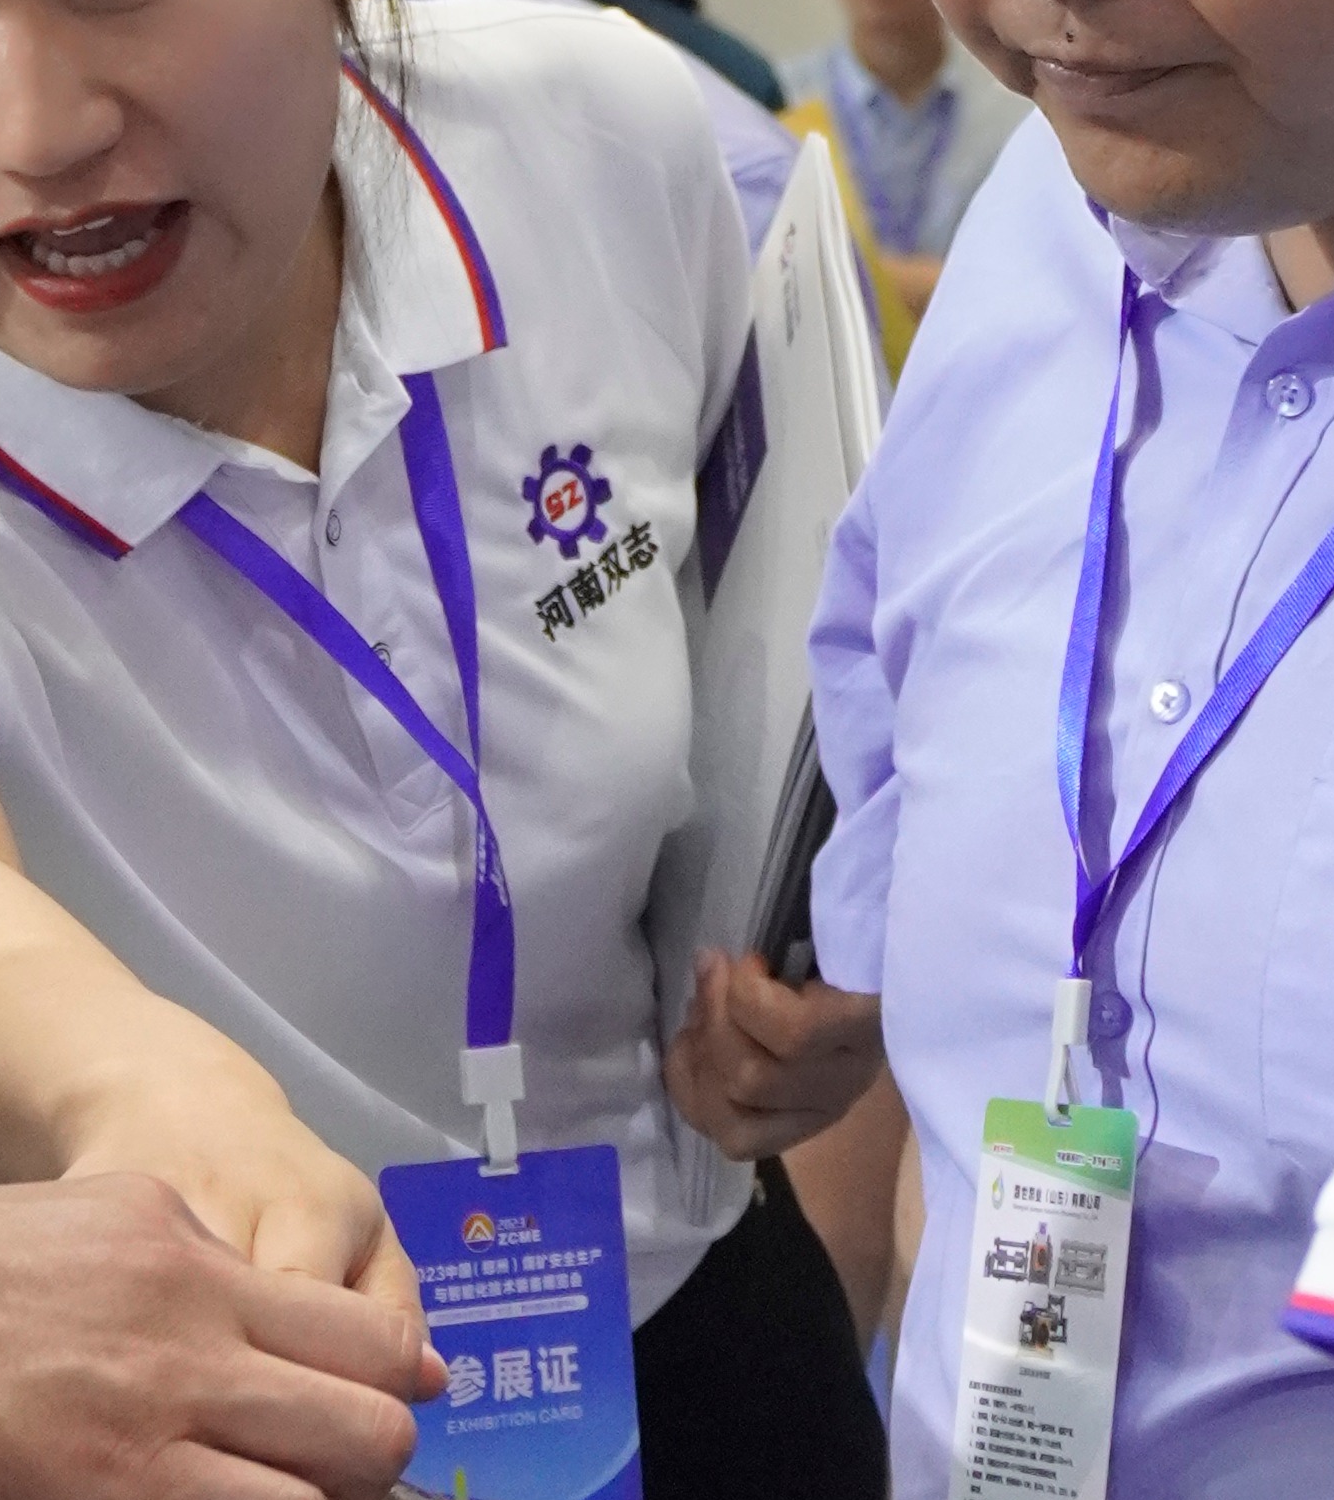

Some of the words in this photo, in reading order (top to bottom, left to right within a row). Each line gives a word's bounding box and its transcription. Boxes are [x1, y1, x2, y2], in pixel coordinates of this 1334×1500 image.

[543, 479, 584, 523] SZ
[533, 520, 660, 643] 河南双志
[497, 1230, 542, 1246] ZCME
[445, 1345, 583, 1408] 参展证
[446, 1412, 536, 1435] EXHIBITION
[538, 1405, 584, 1424] CARD
